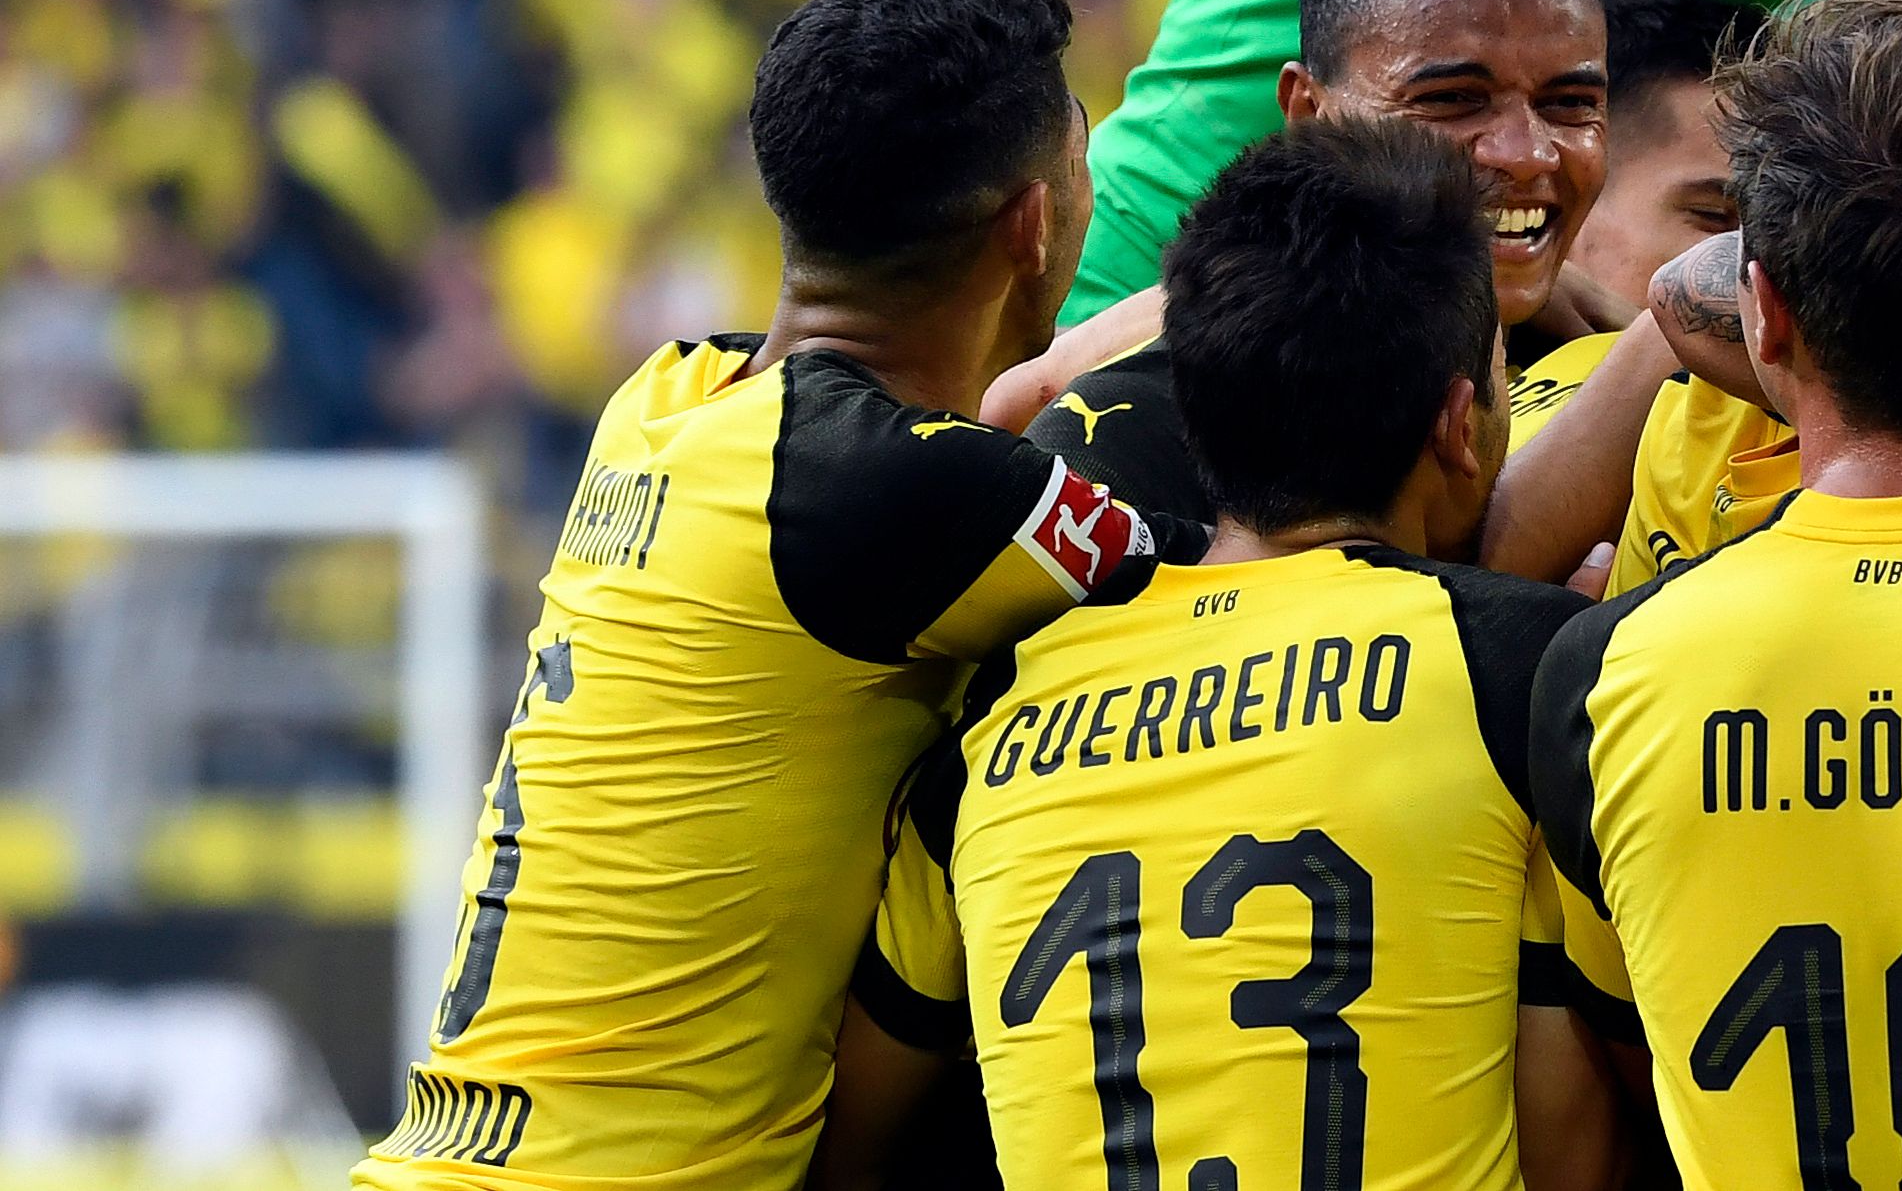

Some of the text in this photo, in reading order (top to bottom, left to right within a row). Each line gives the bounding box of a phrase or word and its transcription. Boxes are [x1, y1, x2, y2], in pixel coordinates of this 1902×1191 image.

[1193, 588, 1241, 618] BVB
[983, 633, 1413, 788] GUERREIRO
[1000, 828, 1374, 1191] 13
